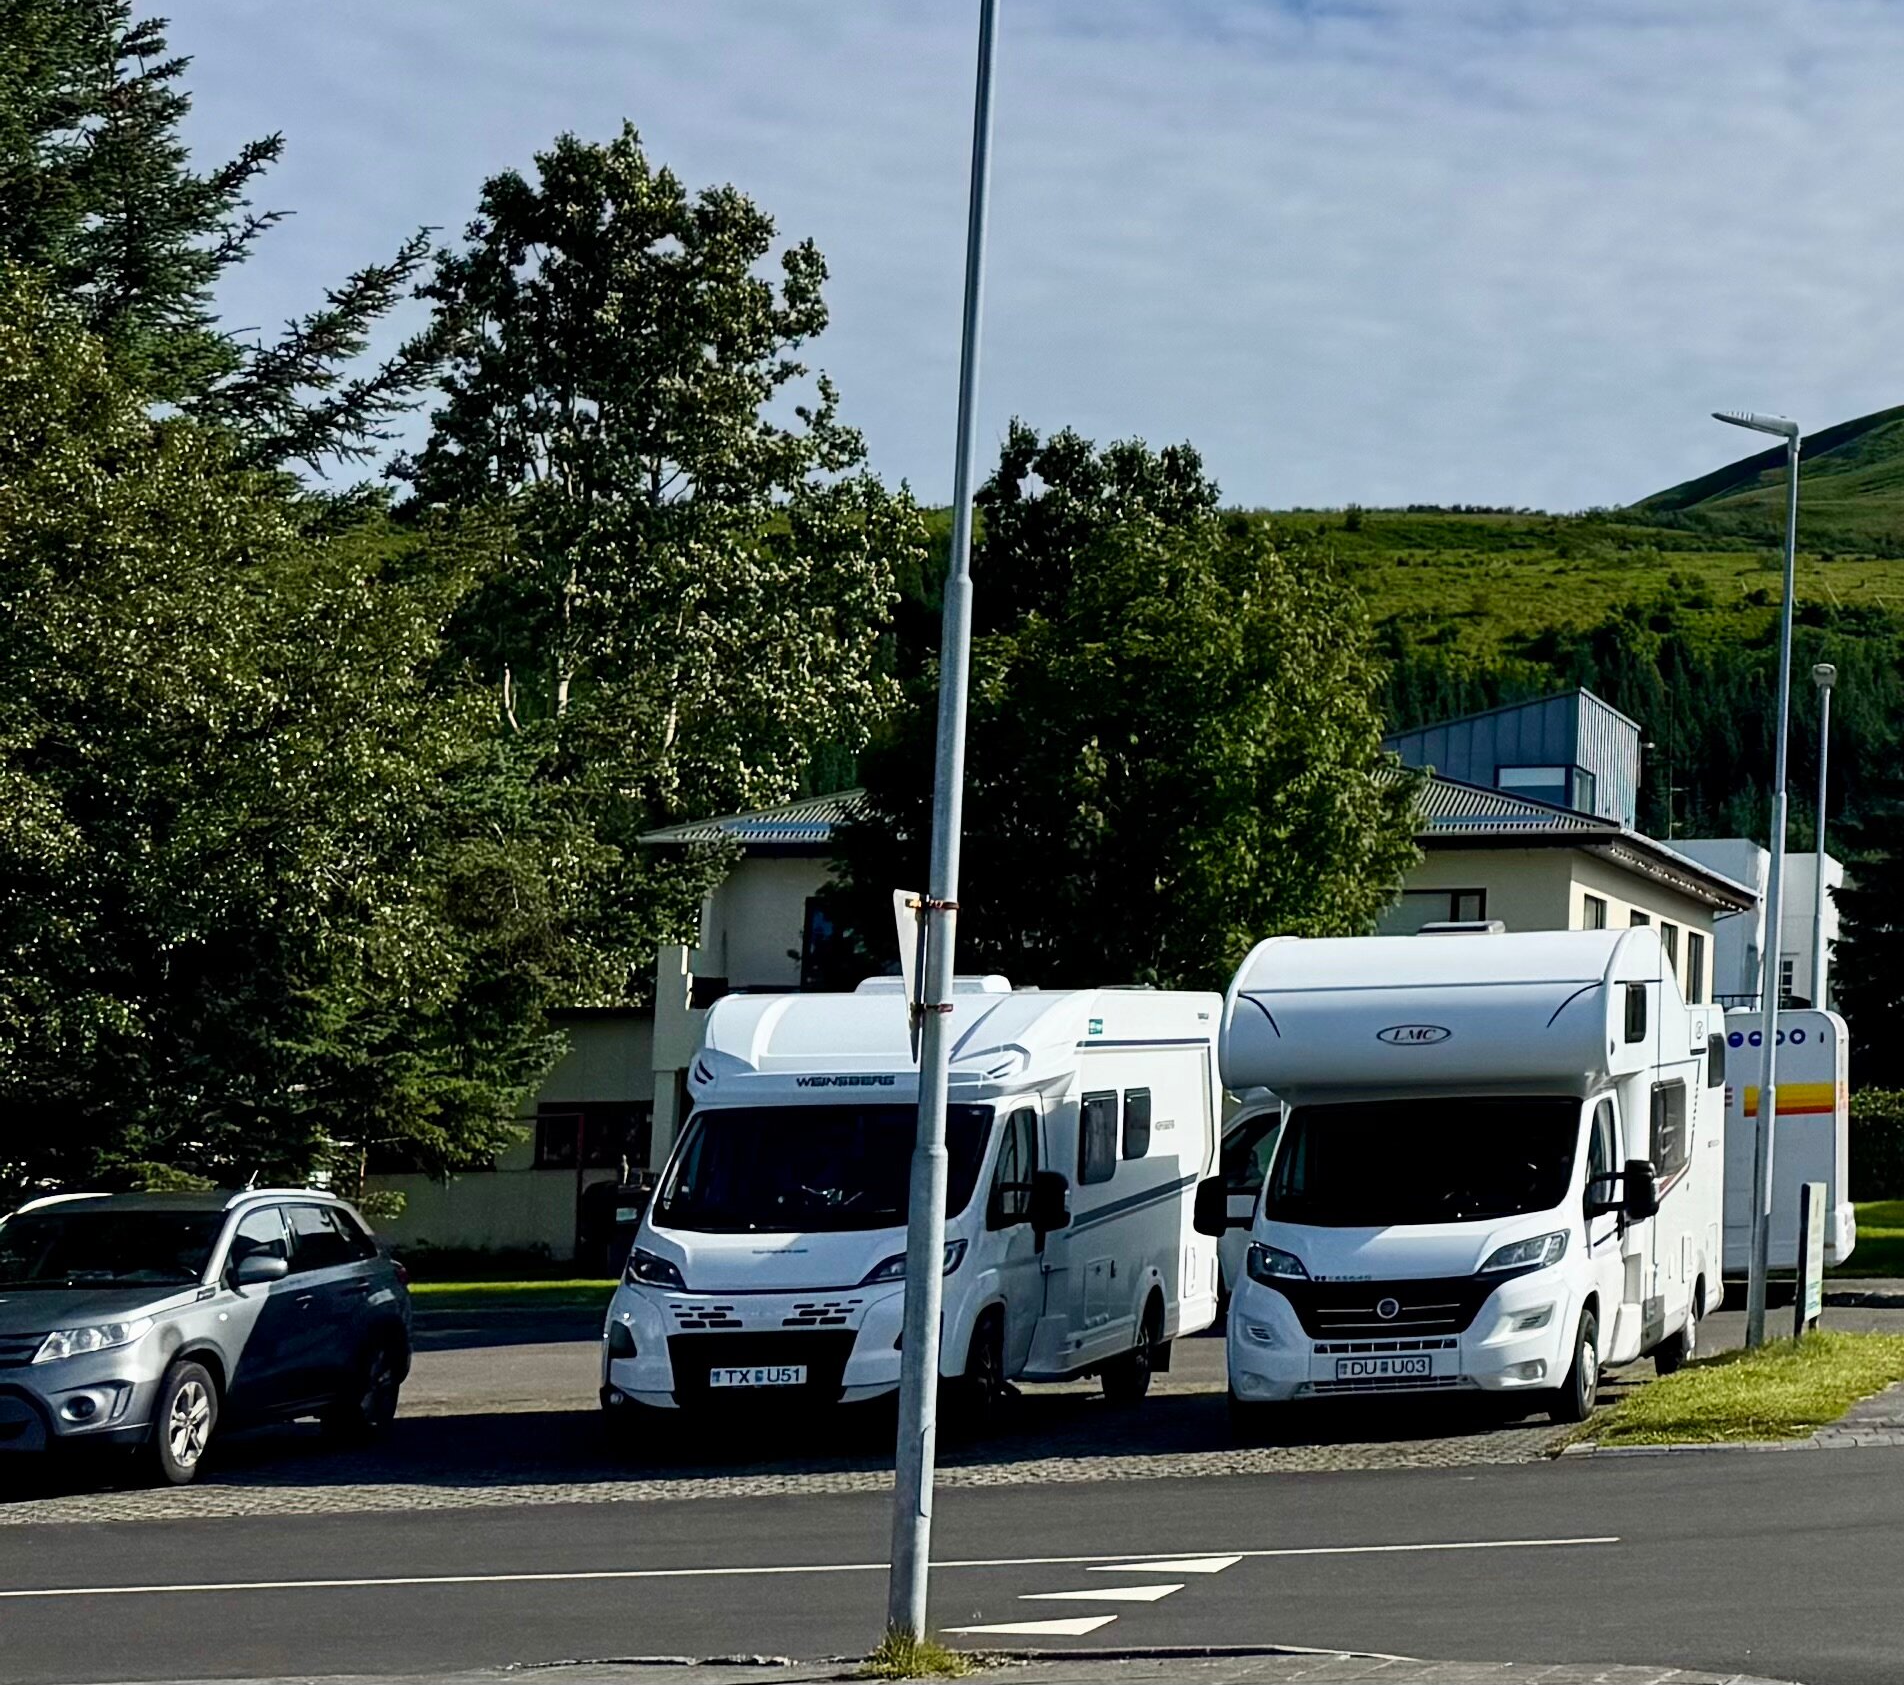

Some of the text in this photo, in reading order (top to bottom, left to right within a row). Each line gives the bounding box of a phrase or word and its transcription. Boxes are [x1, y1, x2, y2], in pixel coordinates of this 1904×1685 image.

[1393, 1029, 1437, 1041] LMC
[796, 1075, 895, 1087] WEINSBERG
[1351, 1359, 1426, 1375] DU U03
[725, 1368, 800, 1384] TX U51
